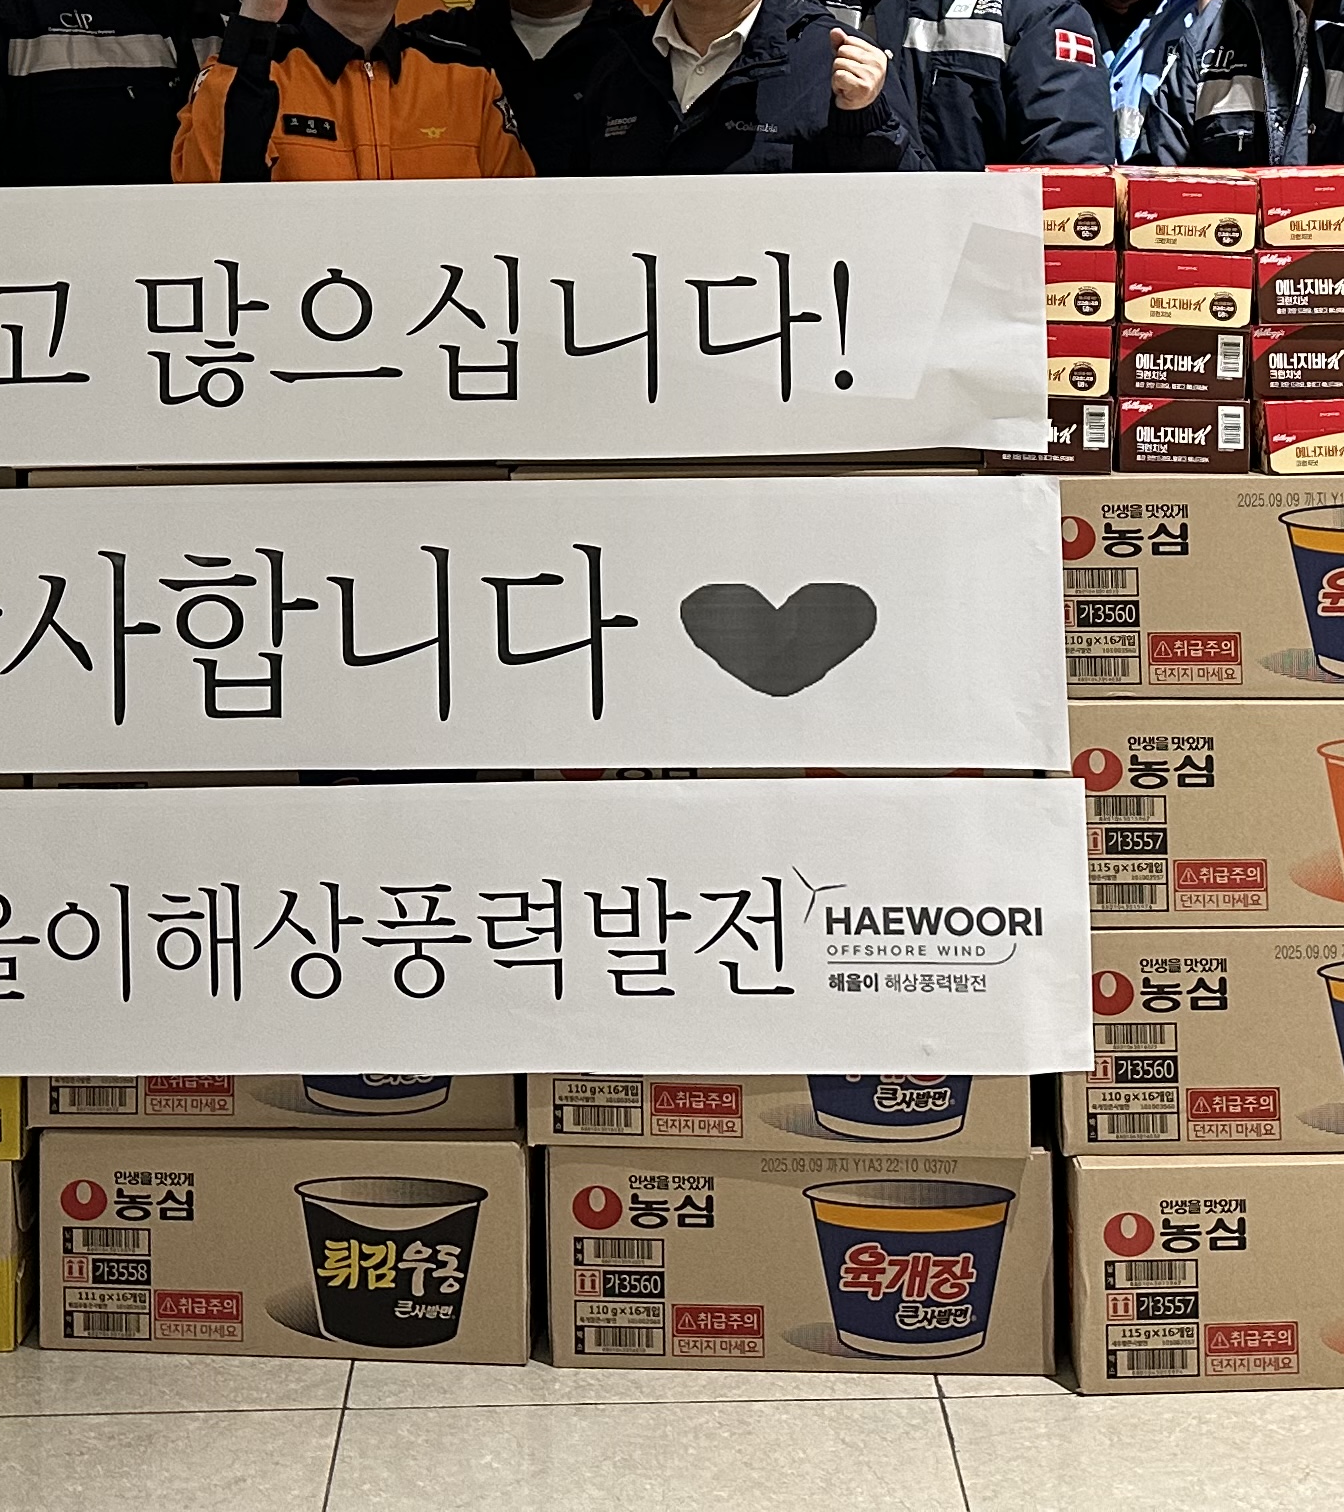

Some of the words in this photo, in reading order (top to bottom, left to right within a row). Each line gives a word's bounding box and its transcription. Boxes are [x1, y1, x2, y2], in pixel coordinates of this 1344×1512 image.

[135, 250, 857, 410] 많으십니다!
[1101, 502, 1144, 520] 인생을
[1145, 502, 1190, 520] 맛있게
[1100, 521, 1191, 558] 농심
[1079, 602, 1137, 624] 가3560
[1172, 638, 1236, 659] 취급주의
[1154, 666, 1195, 683] 던지지
[1196, 666, 1237, 682] 마세요
[1127, 735, 1170, 751] 인생을
[1171, 735, 1215, 752] 맛있게
[1126, 754, 1216, 789] 농심
[1107, 830, 1165, 852] 가3557
[1198, 867, 1262, 887] 취급주의
[1179, 893, 1220, 908] 던지지
[1222, 892, 1263, 908] 마세요
[824, 905, 1044, 937] HAEWOORI
[826, 944, 928, 957] OFFSHORE
[937, 945, 987, 957] WIND
[1139, 957, 1182, 974] 인생을
[1182, 957, 1229, 974] 맛있게
[884, 973, 988, 993] 해상풍력발전
[1139, 975, 1229, 1013] 농심
[1117, 1058, 1176, 1081] 가3560
[674, 1090, 738, 1112] 취급주의
[875, 1087, 951, 1112] 큰사발면
[1211, 1093, 1275, 1114] 취급주의
[655, 1117, 695, 1134] 던지지
[697, 1117, 738, 1135] 마세요
[1192, 1122, 1234, 1139] 던지지
[1234, 1122, 1276, 1138] 마세요
[759, 1157, 824, 1174] 2025.09.09
[885, 1157, 920, 1174] 22:10
[922, 1157, 959, 1174] 03707
[113, 1170, 153, 1186] 인생을
[154, 1171, 196, 1187] 맛있게
[627, 1174, 670, 1191] 인생을
[672, 1174, 715, 1192] 맛있게
[112, 1188, 196, 1222] 농심
[627, 1193, 716, 1230] 농심
[1158, 1198, 1203, 1215] 인생을
[1203, 1198, 1248, 1216] 맛있게
[1158, 1216, 1248, 1254] 농심
[94, 1261, 150, 1284] 가3558
[316, 1239, 465, 1295] 튀김우동
[840, 1243, 976, 1303] 육개장
[605, 1273, 662, 1296] 가3560
[177, 1296, 239, 1316] 취급주의
[393, 1299, 454, 1321] 큰사발면
[896, 1303, 972, 1330] 큰사발면
[1138, 1295, 1196, 1317] 가3557
[696, 1310, 759, 1331] 취급주의
[159, 1323, 198, 1338] 던지지
[199, 1324, 240, 1340] 마세요
[1228, 1328, 1294, 1349] 취급주의
[677, 1339, 718, 1355] 던지지
[721, 1339, 760, 1355] 마세요
[1210, 1357, 1252, 1373] 던지지
[1253, 1355, 1294, 1372] 마세요
